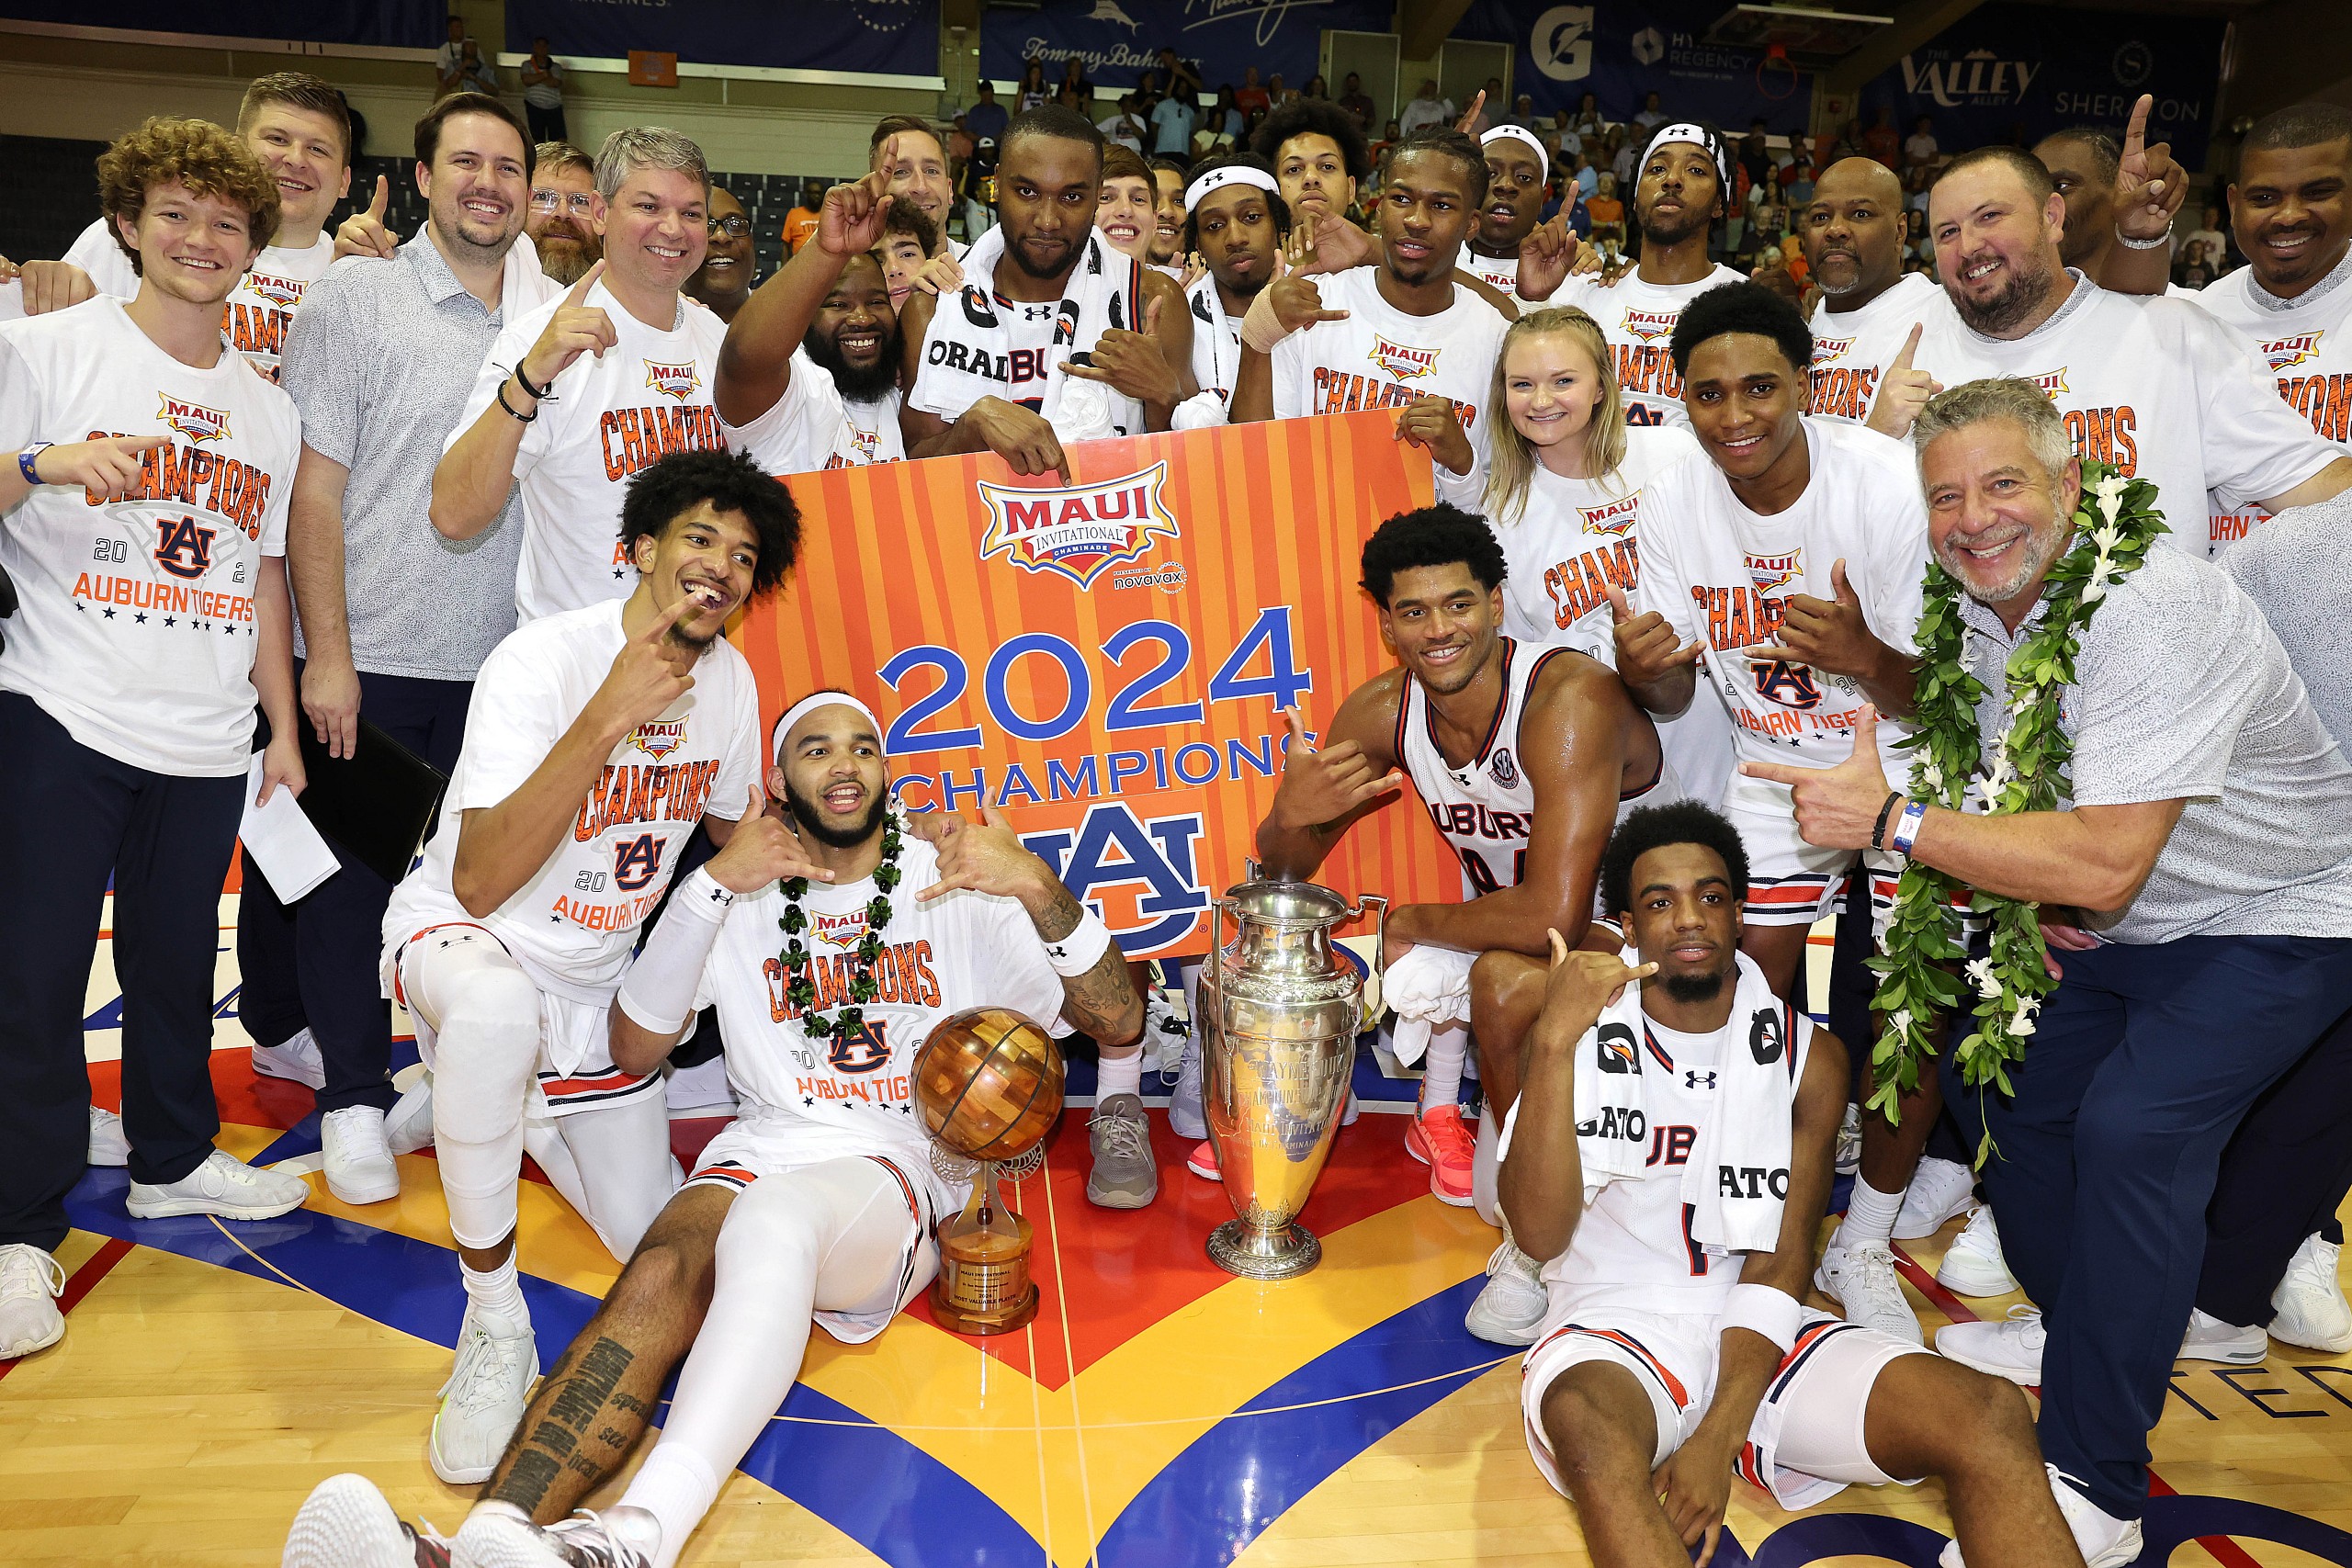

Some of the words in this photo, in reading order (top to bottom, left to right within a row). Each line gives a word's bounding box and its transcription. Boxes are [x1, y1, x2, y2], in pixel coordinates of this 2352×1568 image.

[1022, 37, 1103, 73] Tommy
[1669, 50, 1754, 70] REGENCY
[1926, 49, 1950, 61] THE
[1901, 54, 2041, 107] VALLEY
[1970, 95, 2009, 107] ALLEY
[2054, 92, 2201, 123] SHERON
[253, 275, 303, 296] MAUI
[1628, 312, 1677, 326] MAUI
[1378, 342, 1433, 366] MAUI
[652, 367, 694, 379] MAUI
[167, 400, 224, 429] MAUI
[600, 405, 729, 481] CHAMPIO
[1002, 485, 1151, 536] MAUI
[93, 537, 128, 563] 20
[1036, 527, 1124, 551] INVITATIONAL
[1054, 544, 1109, 557] CHAMINADE
[1114, 570, 1182, 591] novavax
[72, 572, 188, 614] AUBURN
[190, 588, 254, 622] TIGERS
[876, 604, 1313, 758] 2024
[637, 723, 683, 737] MAUI
[574, 870, 606, 893] 20
